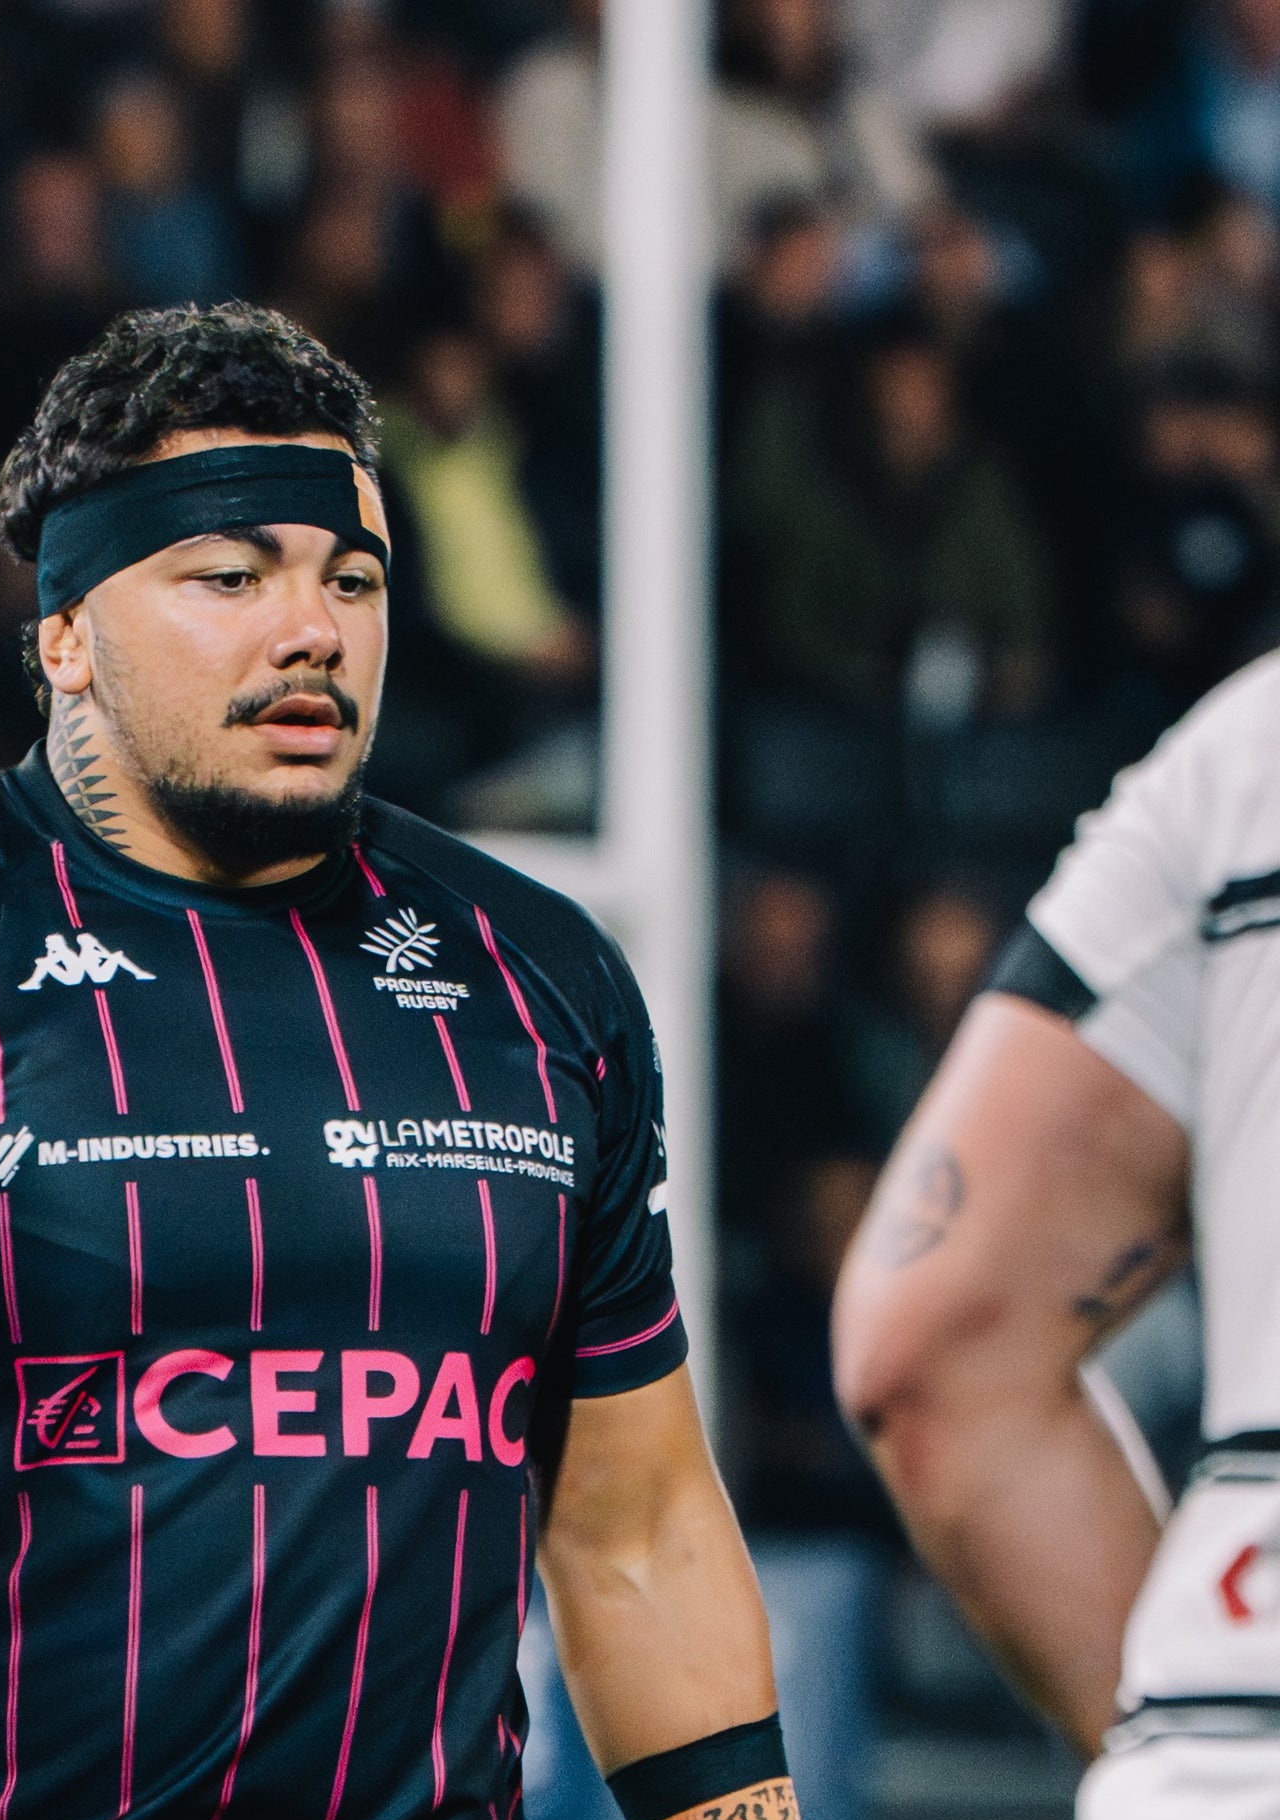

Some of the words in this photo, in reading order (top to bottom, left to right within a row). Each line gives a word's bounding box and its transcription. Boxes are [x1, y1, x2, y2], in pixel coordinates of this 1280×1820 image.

[372, 976, 471, 998] PROVENCE
[395, 993, 458, 1011] RUGBY
[37, 1132, 271, 1166] M-INDUSTRIES.
[132, 1348, 536, 1467] CEPAC
